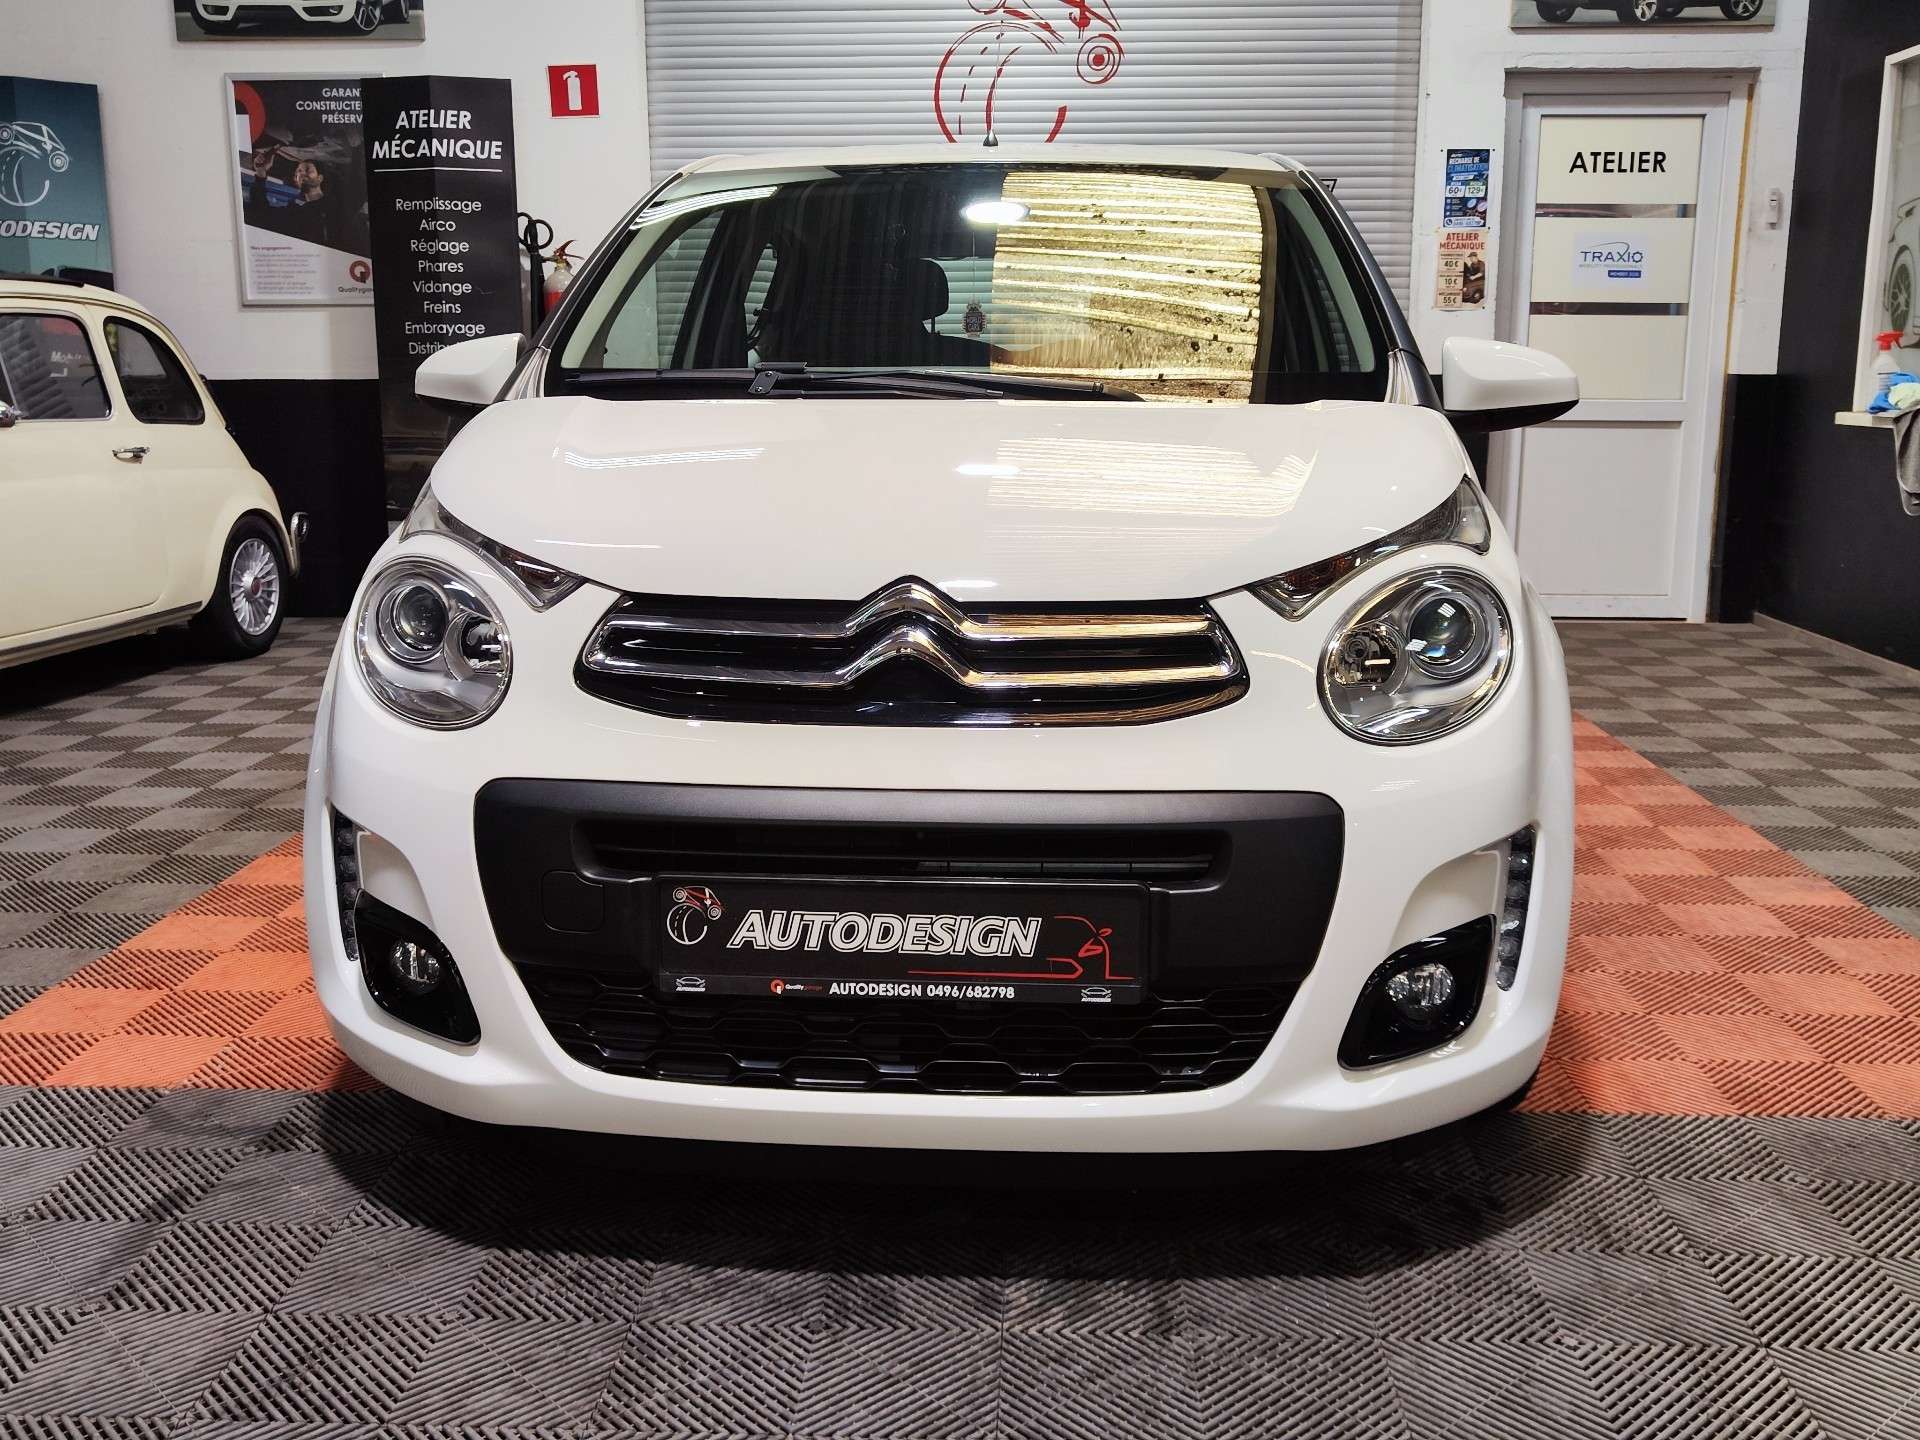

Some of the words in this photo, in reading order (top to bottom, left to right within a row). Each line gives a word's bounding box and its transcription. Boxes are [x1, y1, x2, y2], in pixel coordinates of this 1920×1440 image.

[322, 87, 362, 98] GARAN
[295, 100, 363, 111] CONSTRUCTE
[321, 112, 363, 124] PRÉSERV
[395, 109, 472, 130] ATELIER
[372, 133, 503, 160] MÉCANIQUE
[1568, 151, 1667, 173] ATELIER
[395, 197, 482, 214] Remplissage
[0, 220, 100, 241] ODESIGN
[419, 218, 456, 231] Airco
[1446, 232, 1480, 241] ATELIER
[410, 238, 469, 255] Réglage
[1439, 241, 1485, 250] MÉCANIQUE
[1579, 251, 1644, 263] TRAXIO
[418, 259, 464, 273] Phares
[412, 280, 472, 296] Vidange
[423, 301, 462, 314] Freins
[404, 321, 486, 337] Embrayage
[408, 341, 460, 355] Distrib
[726, 909, 1043, 957] AUTODESIGN
[829, 982, 922, 997] AUTODESIGN
[926, 984, 1015, 998] 0496/682798
